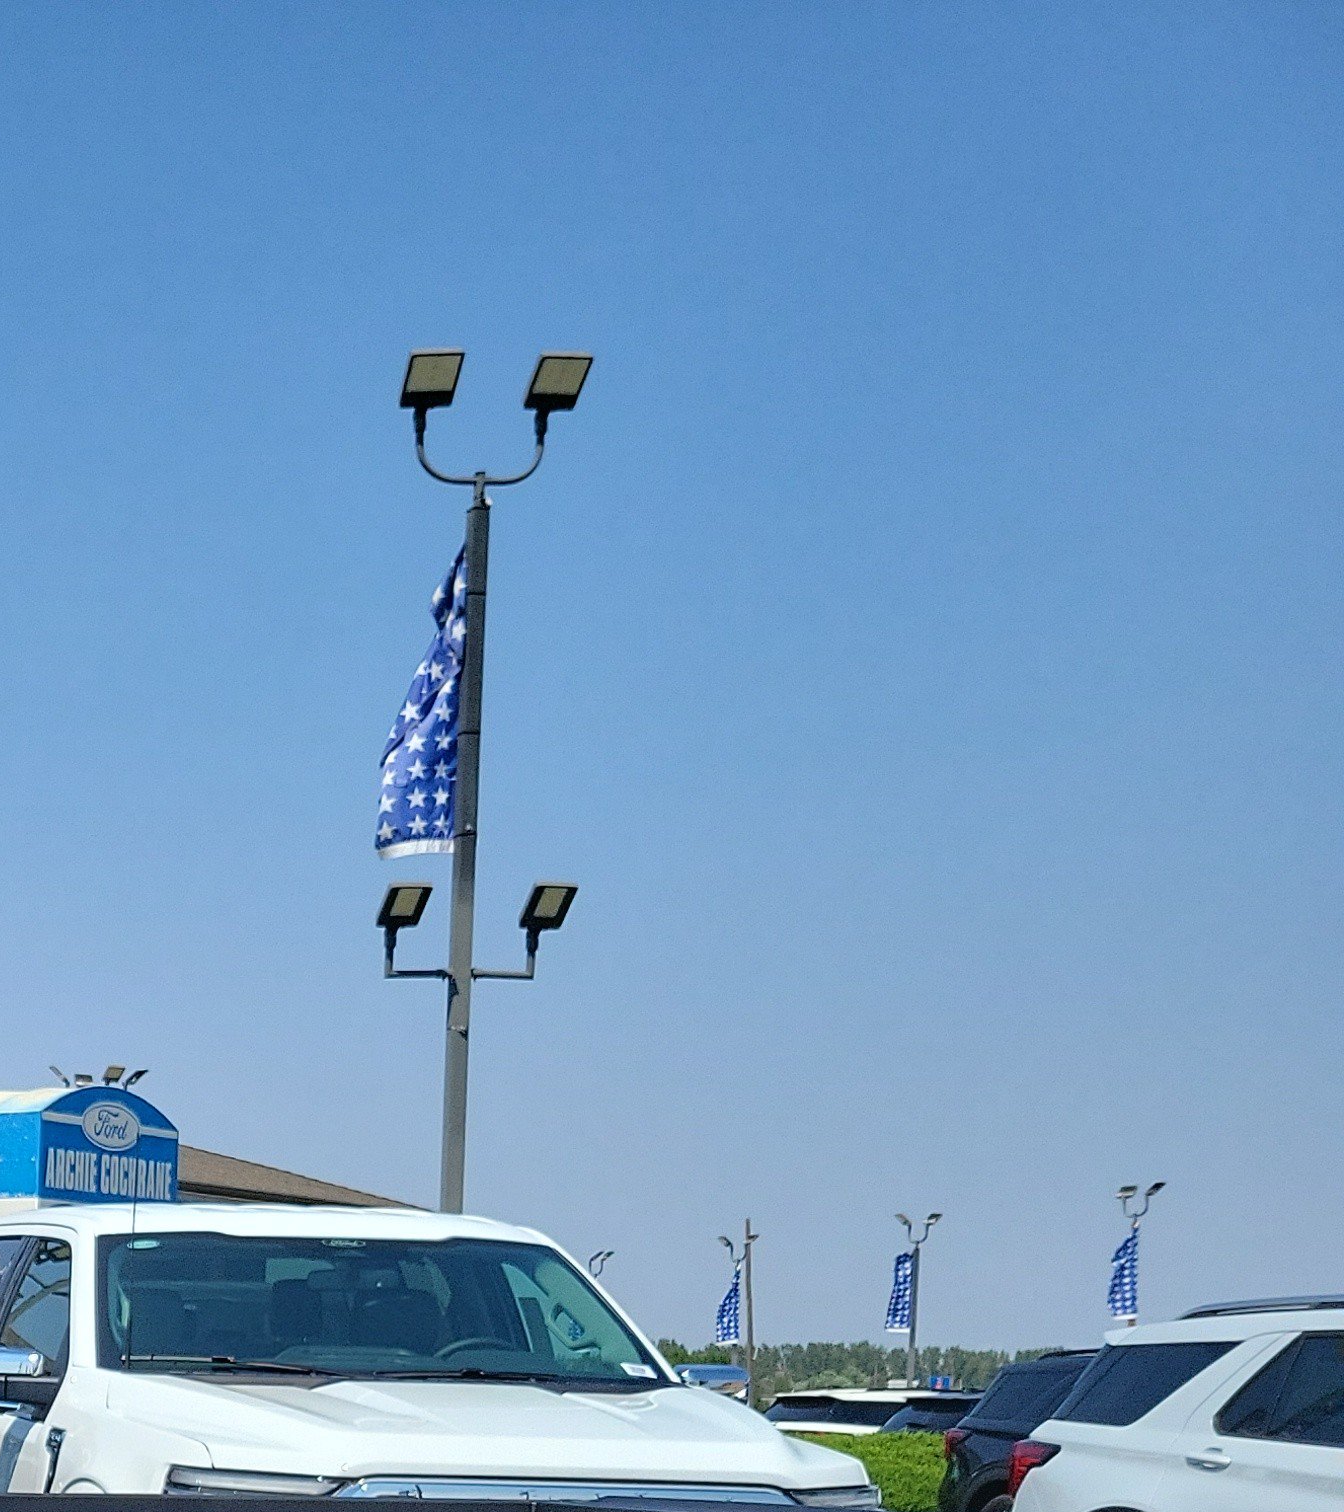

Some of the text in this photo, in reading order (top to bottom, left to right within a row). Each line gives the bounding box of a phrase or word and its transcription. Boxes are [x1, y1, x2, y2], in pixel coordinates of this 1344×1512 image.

[93, 1109, 127, 1141] Ford
[44, 1147, 172, 1200] ARCHIE COCHRANE
